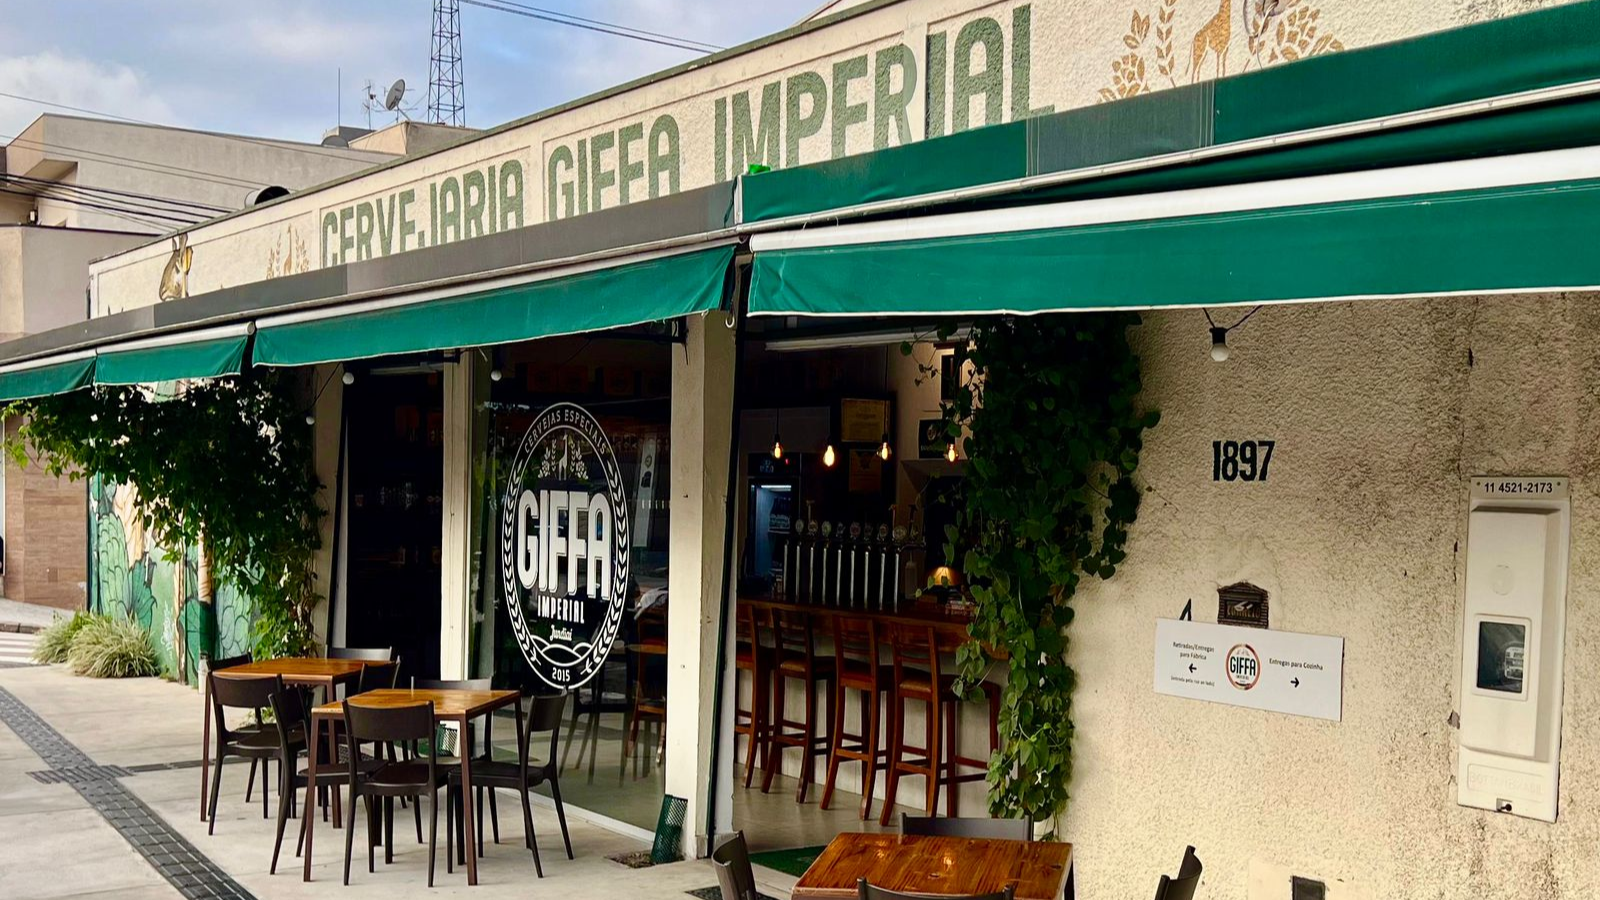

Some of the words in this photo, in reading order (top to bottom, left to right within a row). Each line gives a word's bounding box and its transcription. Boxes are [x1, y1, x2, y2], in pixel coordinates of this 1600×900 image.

[321, 159, 524, 267] CERVEJARIA
[548, 119, 681, 222] GIFFA
[714, 3, 1055, 184] IMPERIAL
[525, 410, 561, 454] CERVEJAS
[564, 409, 607, 455] ESPECIAIS
[1212, 440, 1275, 481] 1897
[1484, 481, 1495, 494] 11
[1498, 481, 1554, 494] 4521-2173
[517, 489, 612, 600] GIFFA
[537, 594, 585, 624] IMPERIAL
[551, 665, 571, 683] 2015
[1229, 655, 1256, 677] GIFFA
[1269, 657, 1290, 668] Entregas
[1291, 661, 1302, 669] para
[1303, 660, 1323, 671] Cozinha
